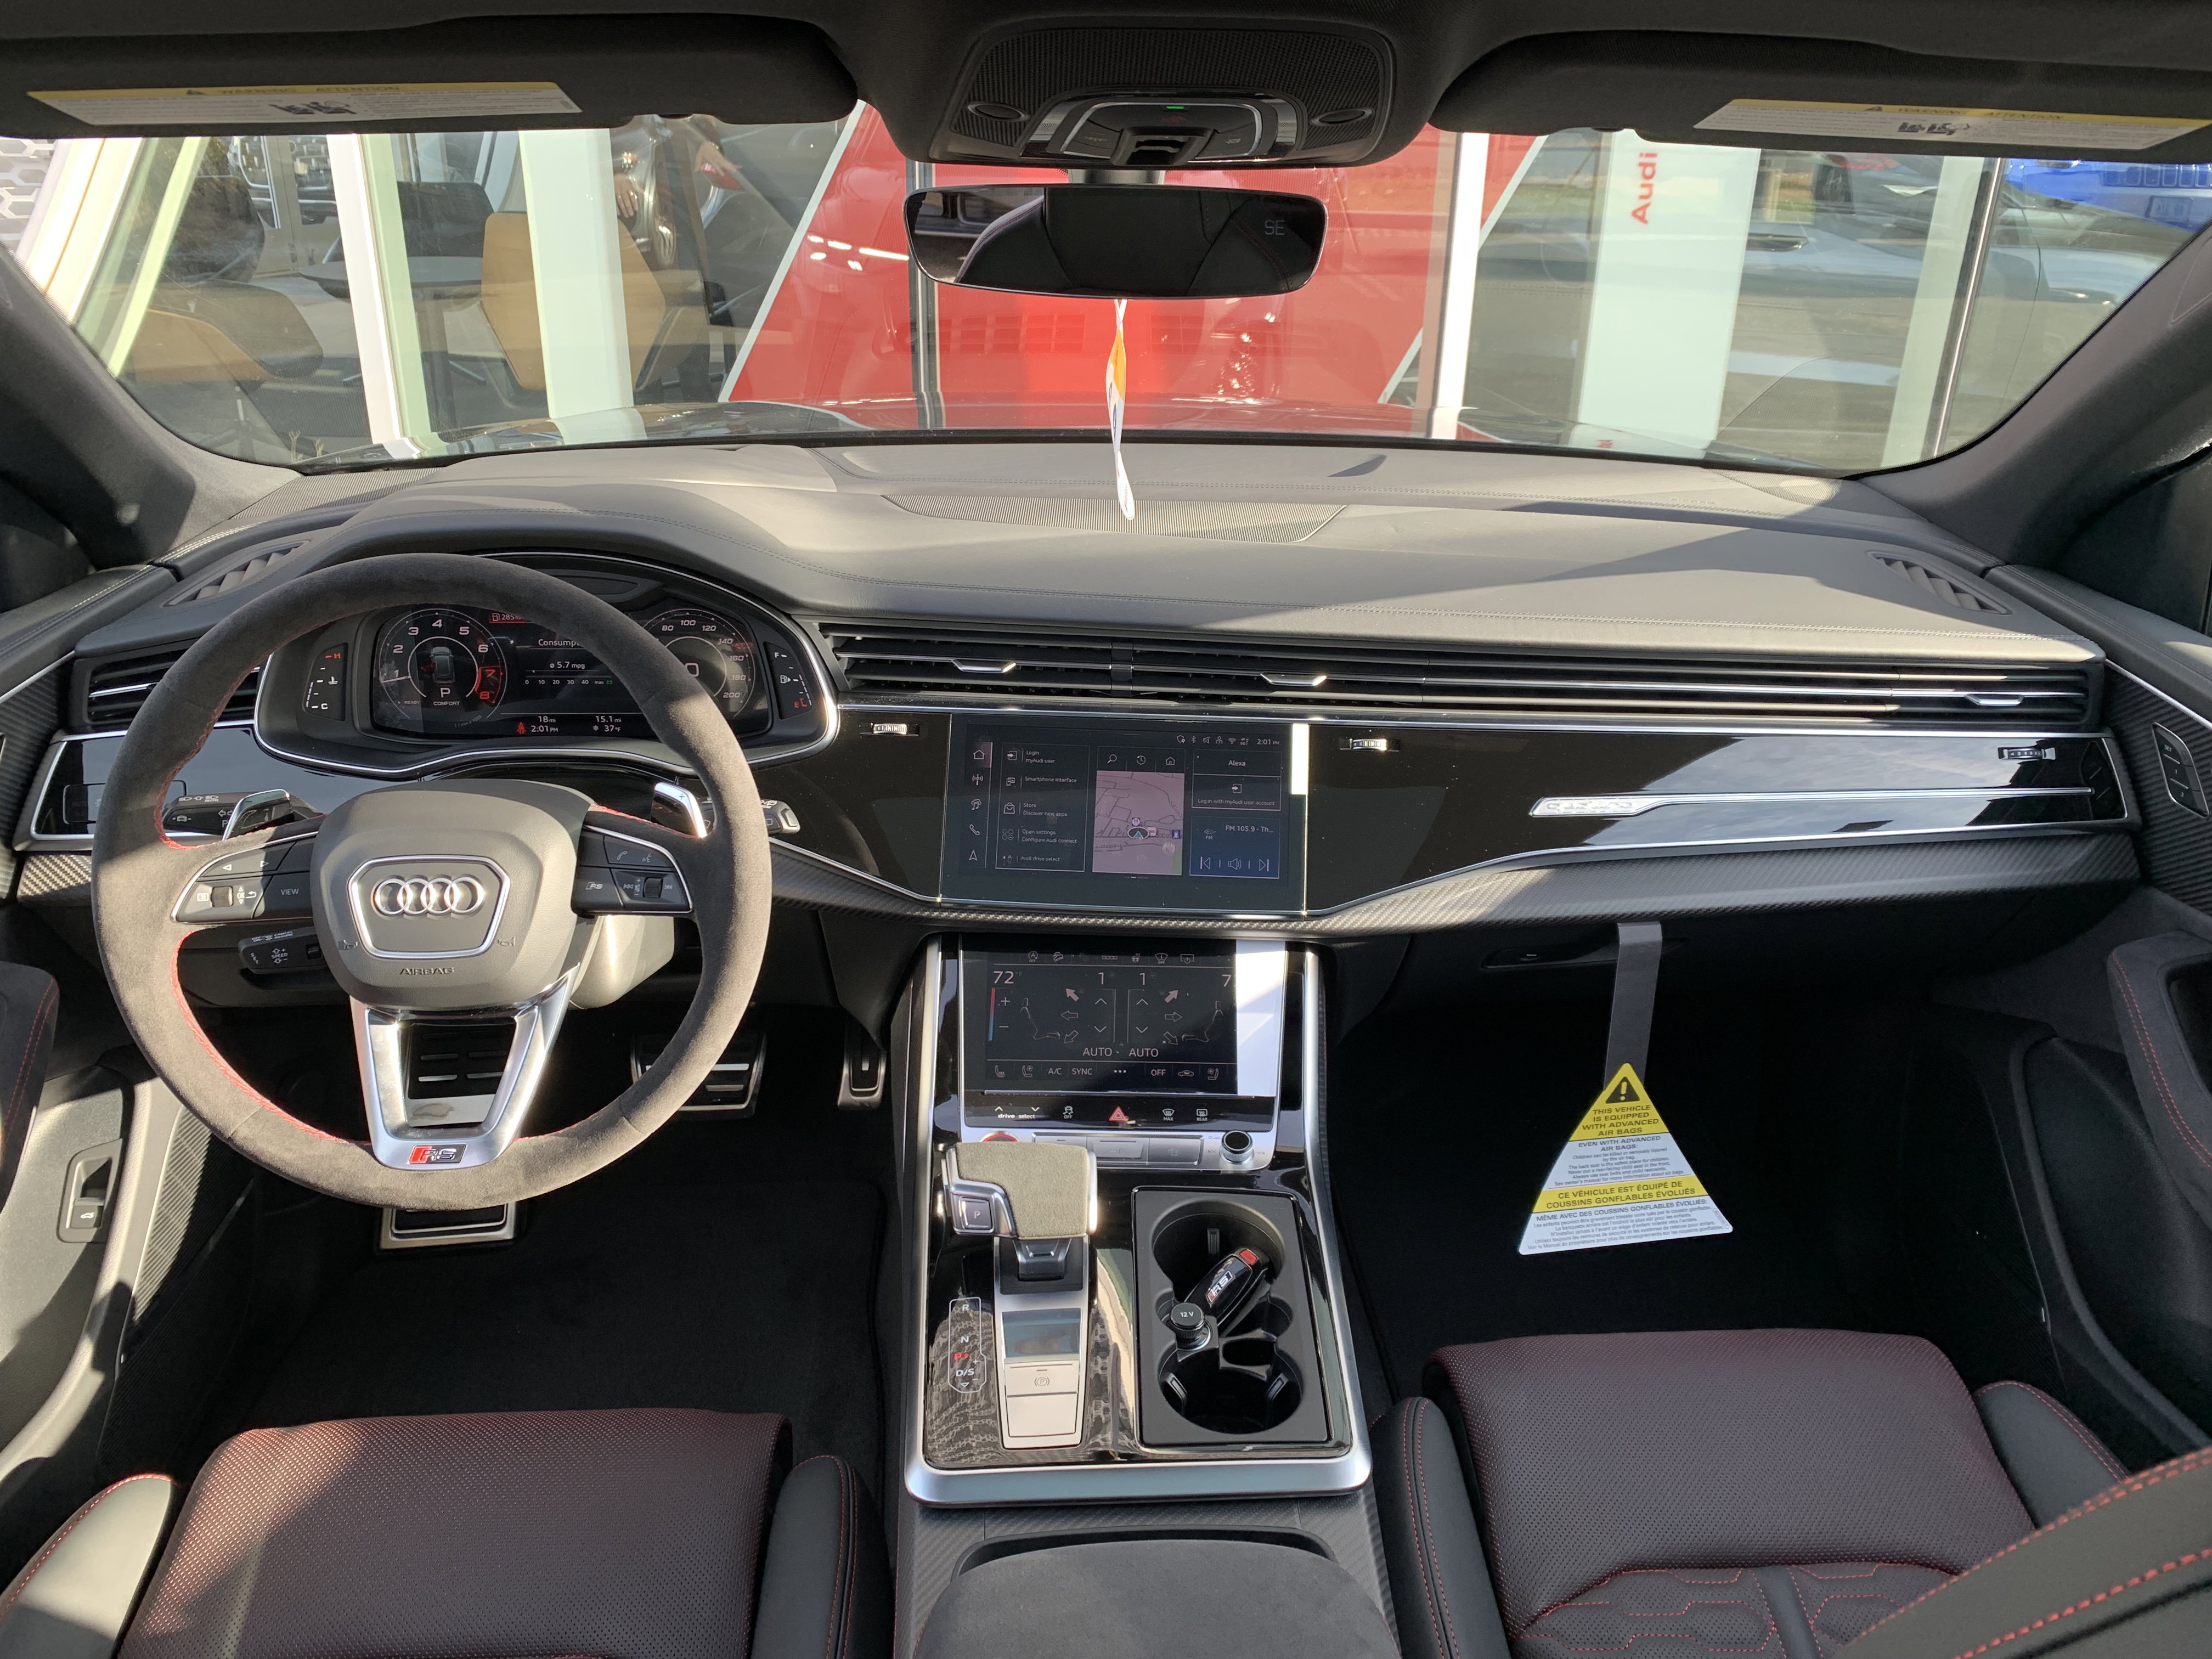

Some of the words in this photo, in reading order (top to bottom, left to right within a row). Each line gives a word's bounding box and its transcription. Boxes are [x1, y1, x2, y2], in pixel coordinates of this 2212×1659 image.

[1631, 153, 1658, 224] Audi
[1265, 220, 1285, 236] SE
[432, 619, 443, 628] 4
[408, 627, 419, 635] 3
[459, 627, 470, 635] 5
[393, 645, 404, 653] 2
[478, 645, 489, 653] 6
[485, 669, 496, 678] 7
[440, 687, 451, 698] P
[479, 691, 490, 699] 8
[399, 967, 455, 975] AIRBAG
[994, 970, 1014, 984] 72
[1098, 972, 1104, 985] 1
[1139, 973, 1146, 985] 1
[1082, 1047, 1112, 1057] AUTO
[1129, 1048, 1159, 1057] AUTO
[1615, 1105, 1651, 1113] VEHICLE
[1605, 1113, 1649, 1121] EQUIPPED
[1609, 1119, 1659, 1128] ADVANCED
[1572, 1188, 1615, 1198] VÉHICULE
[1637, 1181, 1668, 1191] ÉQUIPÉ
[1547, 1198, 1592, 1209] COUSSINS
[1595, 1192, 1654, 1204] GONFLABLES
[1656, 1188, 1695, 1197] ÉVOLUÉS
[1630, 1202, 1674, 1212] GONFLABLES
[1676, 1199, 1708, 1207] ÉVOLUÉS:
[974, 1210, 980, 1218] P
[956, 1368, 974, 1376] D/S
